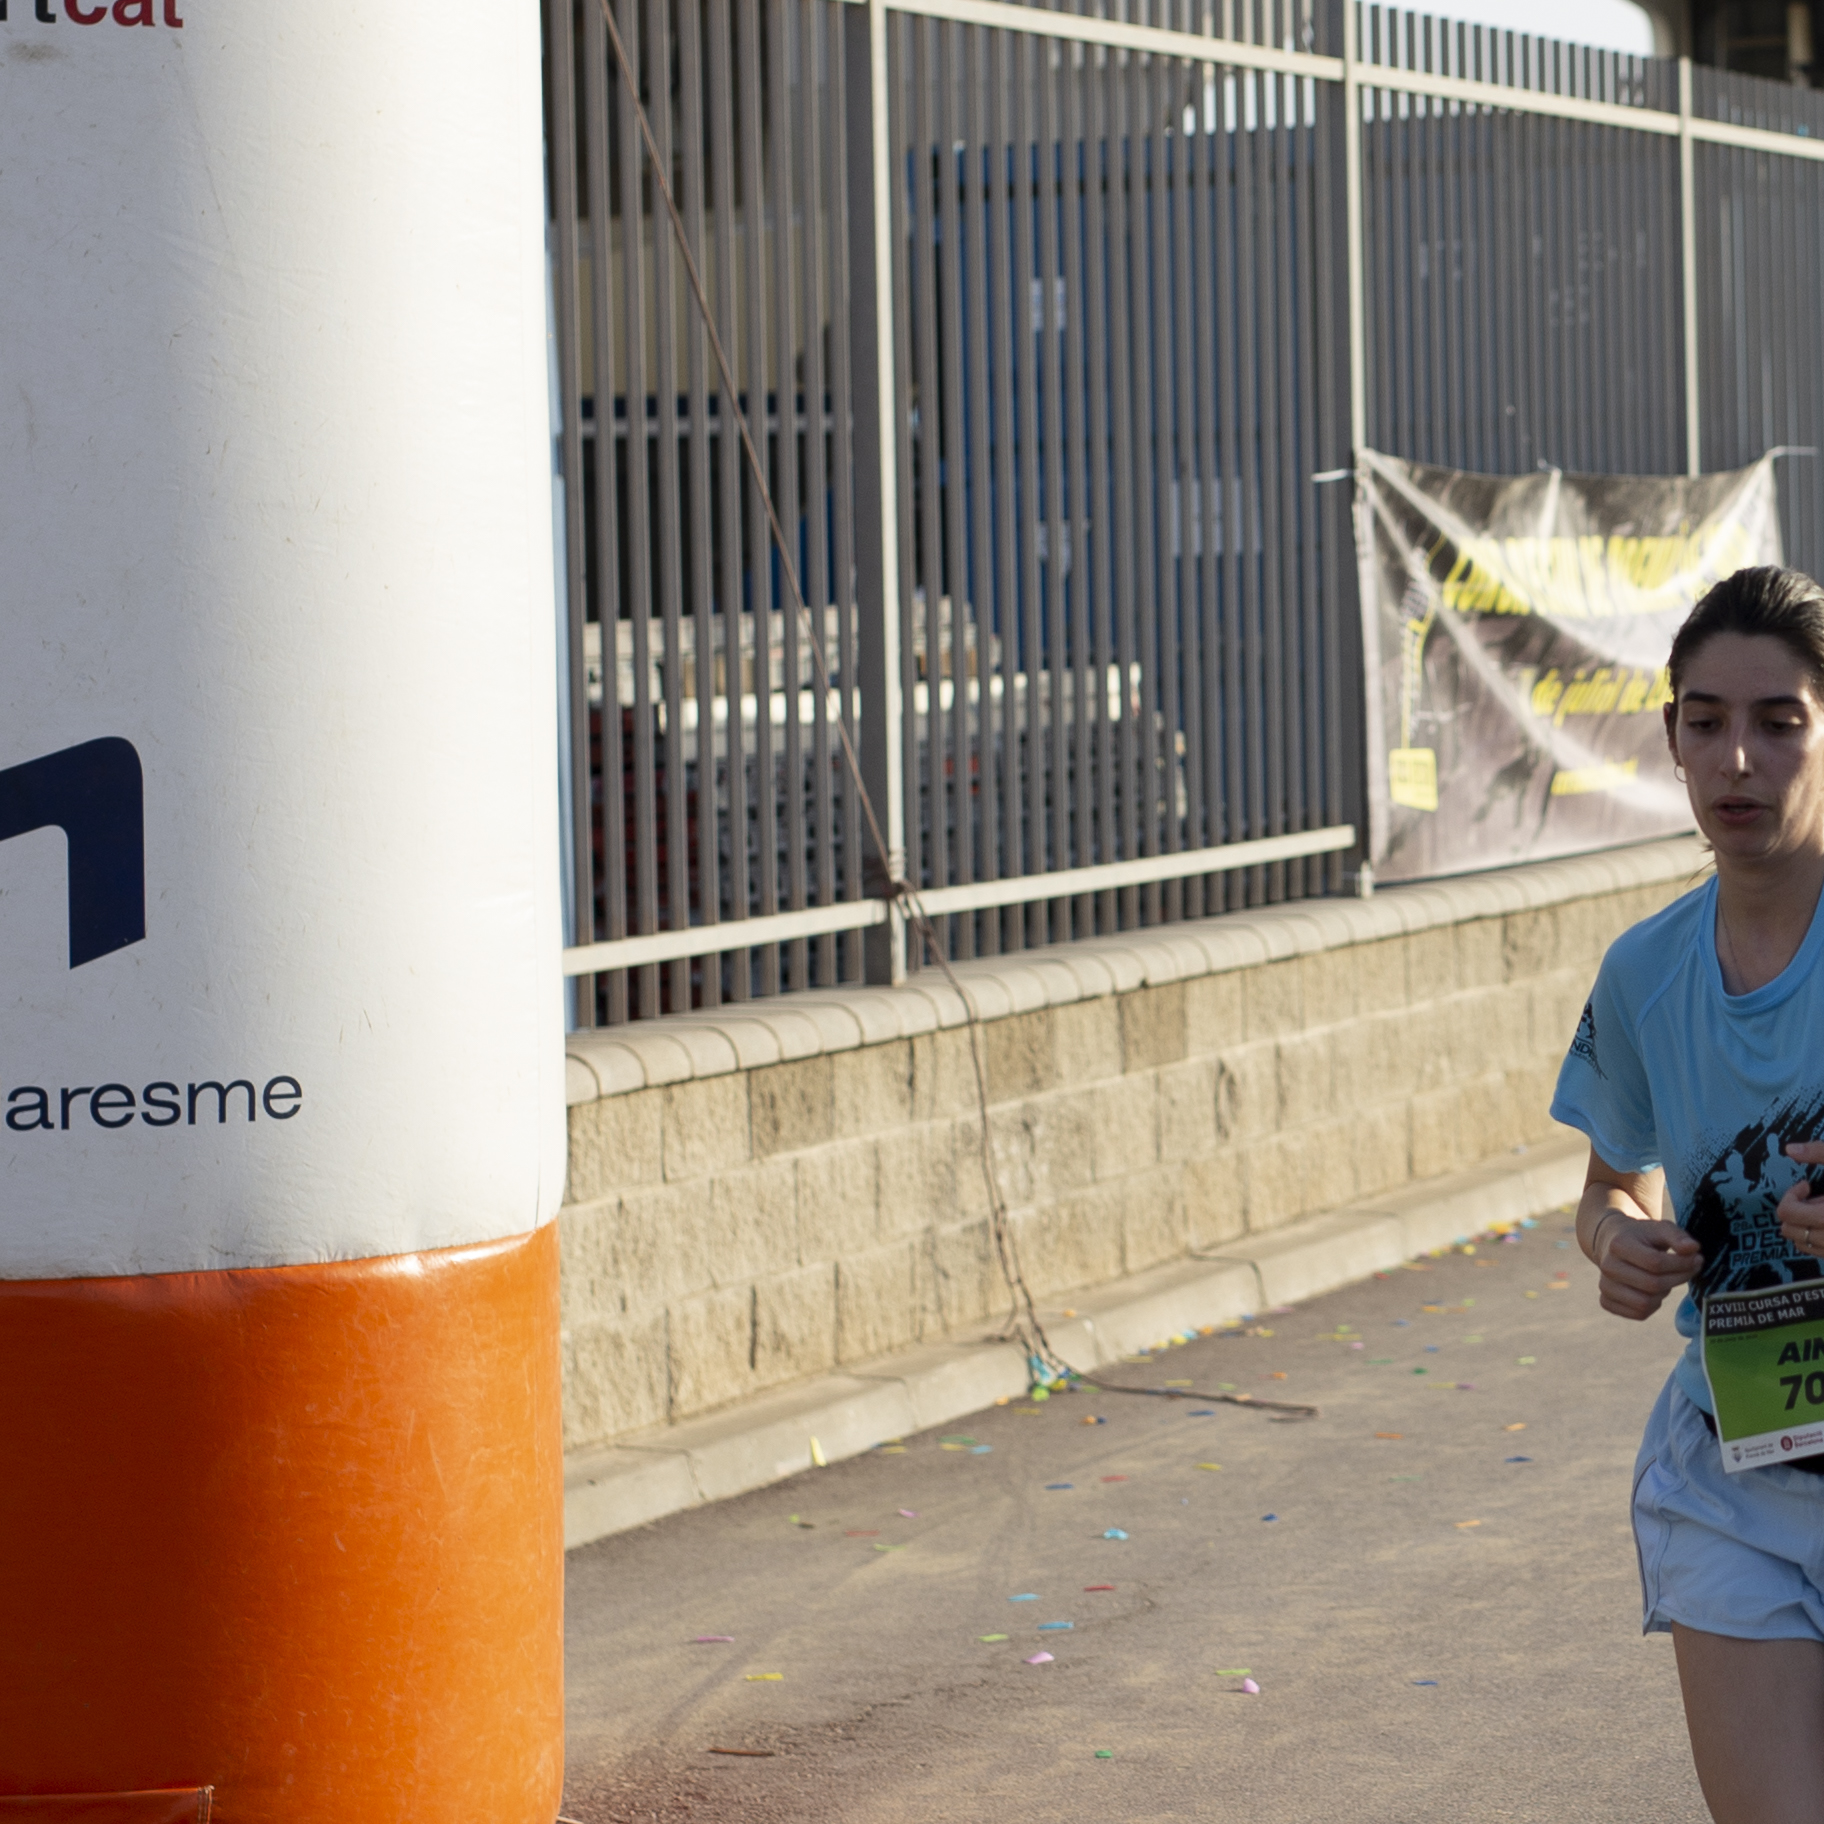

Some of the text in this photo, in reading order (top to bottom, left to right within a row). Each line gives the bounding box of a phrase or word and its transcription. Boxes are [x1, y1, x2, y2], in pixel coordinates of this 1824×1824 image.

[4, 1074, 303, 1132] aresme
[1708, 1300, 1746, 1315] XXVIII
[1748, 1295, 1790, 1312] CURSA
[1757, 1311, 1775, 1324] DE
[1778, 1306, 1805, 1321] MAR
